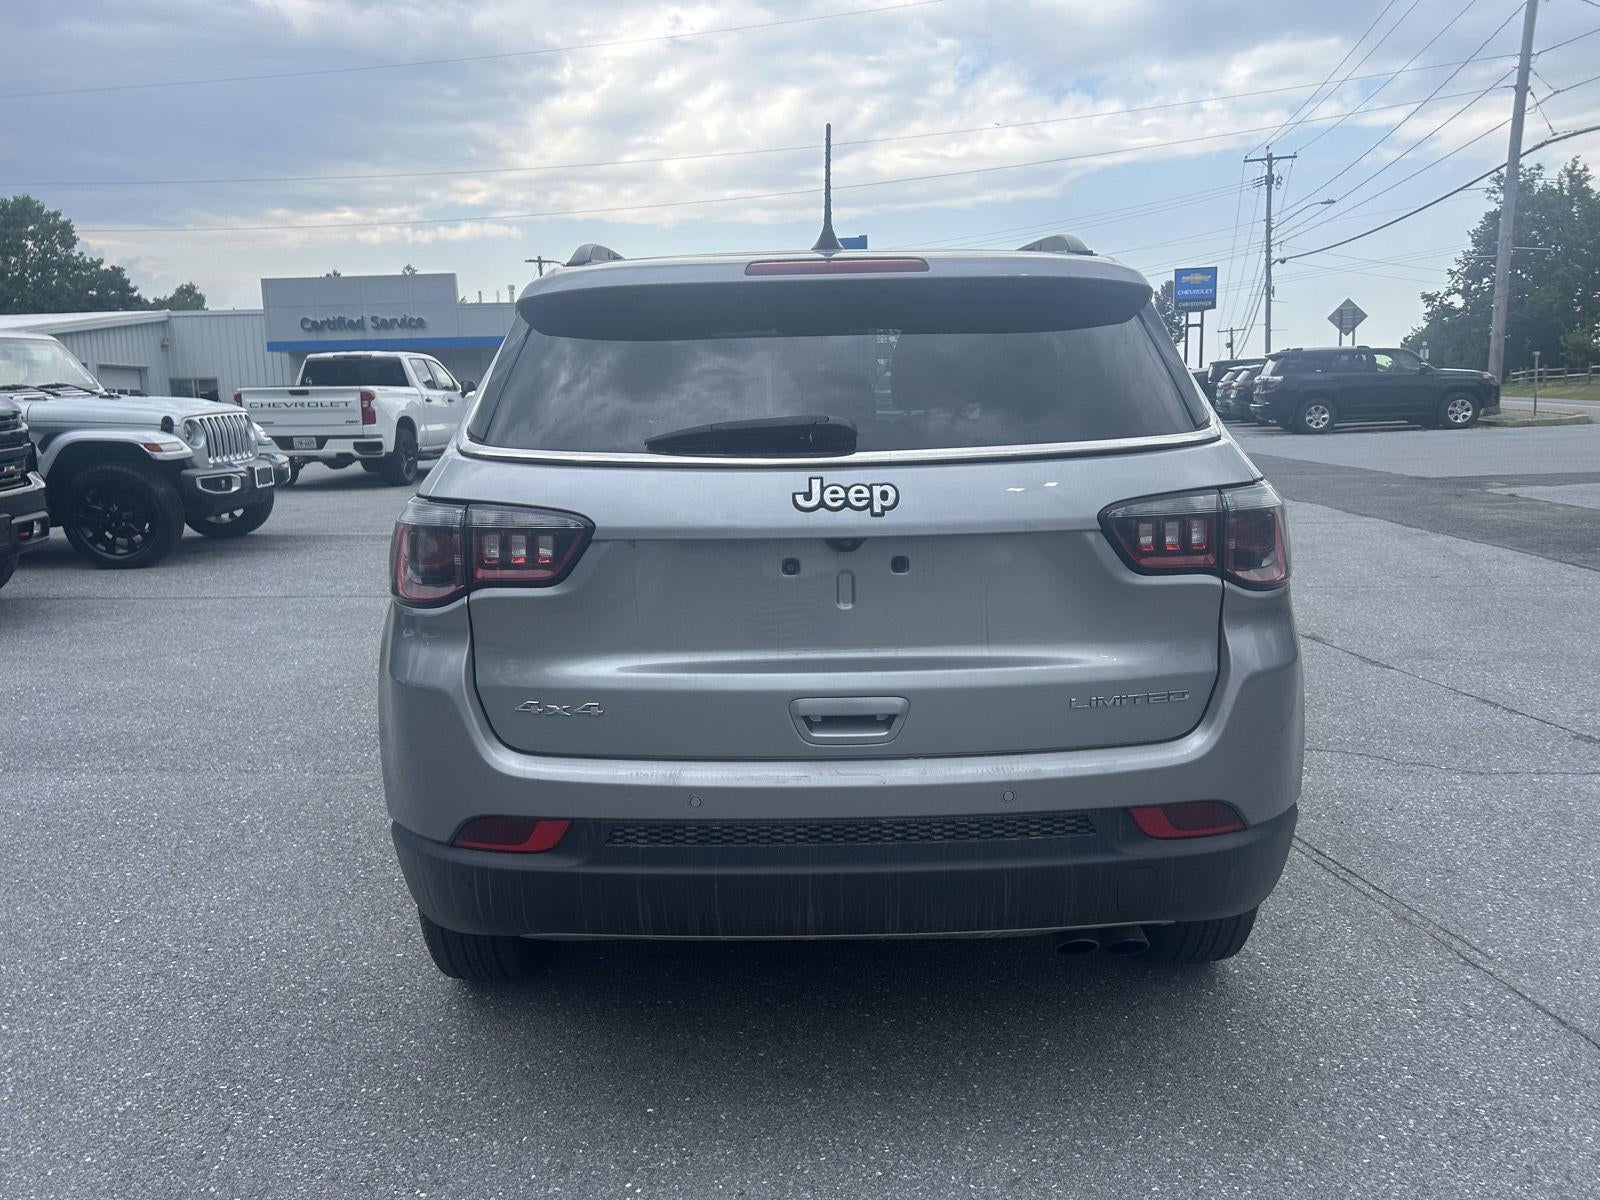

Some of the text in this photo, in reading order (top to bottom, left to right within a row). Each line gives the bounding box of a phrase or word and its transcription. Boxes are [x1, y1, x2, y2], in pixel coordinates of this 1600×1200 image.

[300, 314, 426, 332] Certified Service
[249, 401, 352, 409] CHEVROLET
[792, 476, 900, 517] Jeep
[514, 700, 604, 716] 4x4
[1069, 689, 1190, 709] LIMITED
